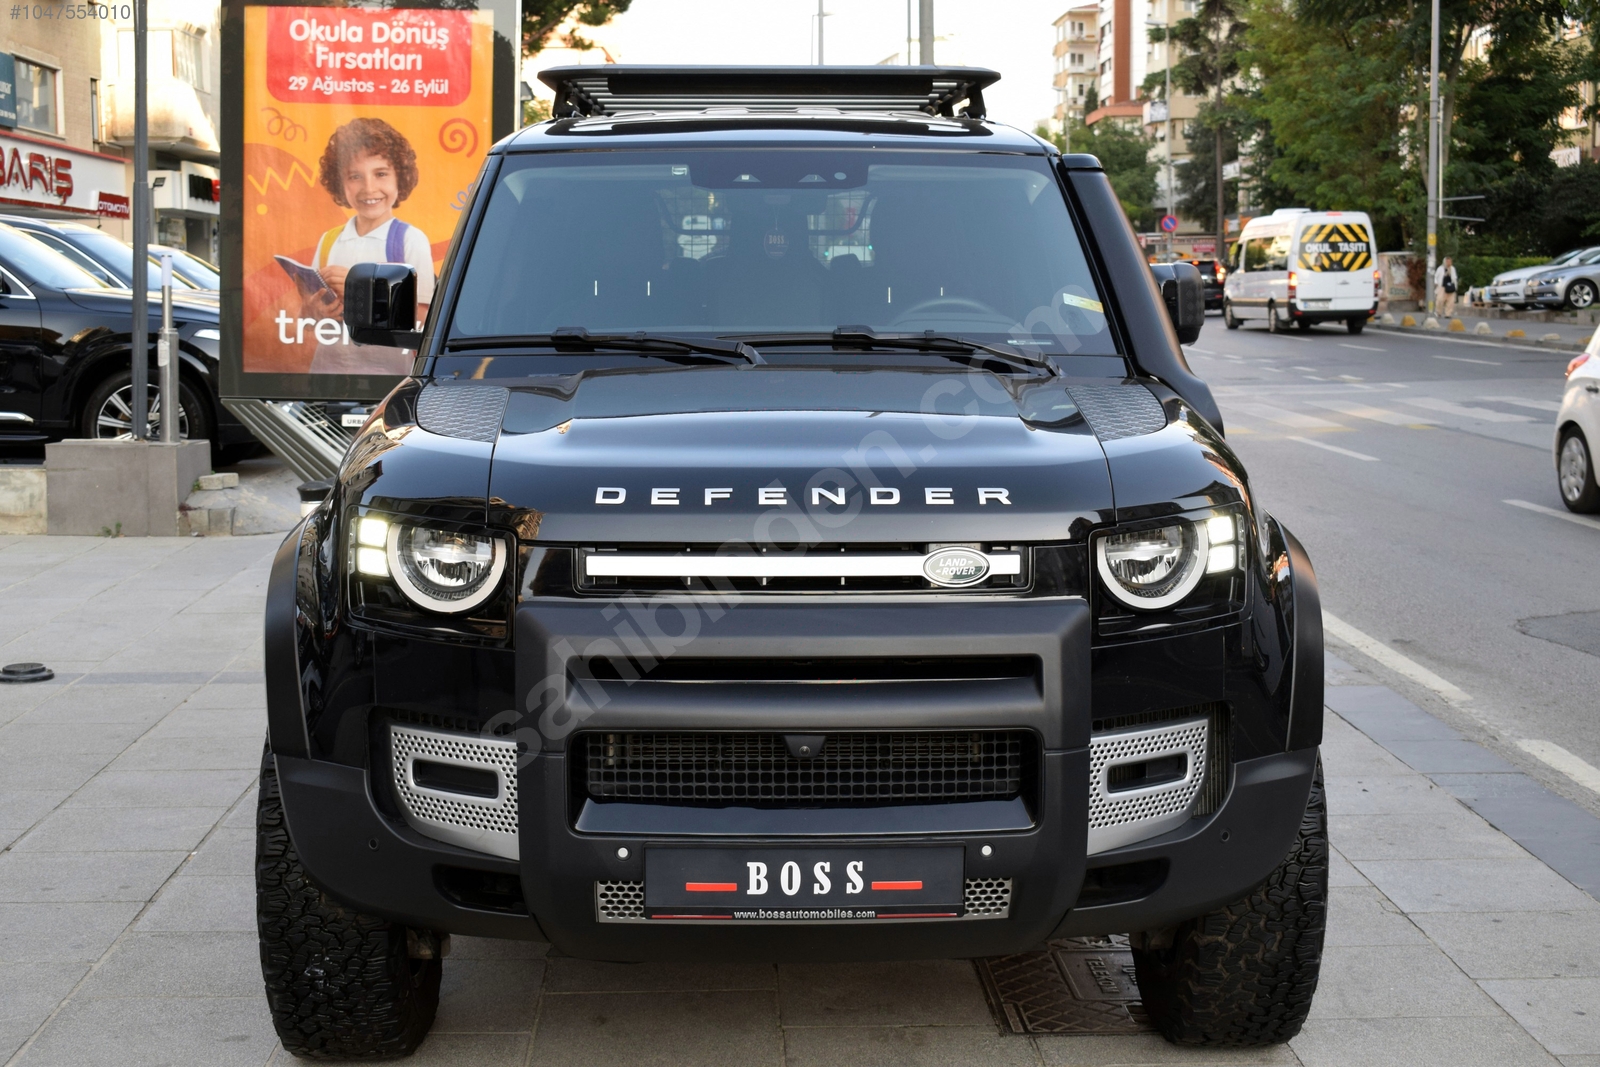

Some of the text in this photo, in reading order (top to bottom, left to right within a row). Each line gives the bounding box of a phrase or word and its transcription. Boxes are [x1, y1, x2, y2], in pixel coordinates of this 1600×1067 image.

[289, 18, 450, 51] Okula Dönüş
[315, 46, 423, 71] Fırsatları
[288, 76, 309, 91] 29
[312, 75, 375, 95] Ağustos
[390, 79, 411, 94] 26
[414, 78, 449, 98] Eylül
[1305, 243, 1332, 253] OKUL
[594, 486, 1013, 506] DEFENDER
[746, 860, 864, 896] BOSS
[734, 908, 876, 919] www.bossautomobiles.com
